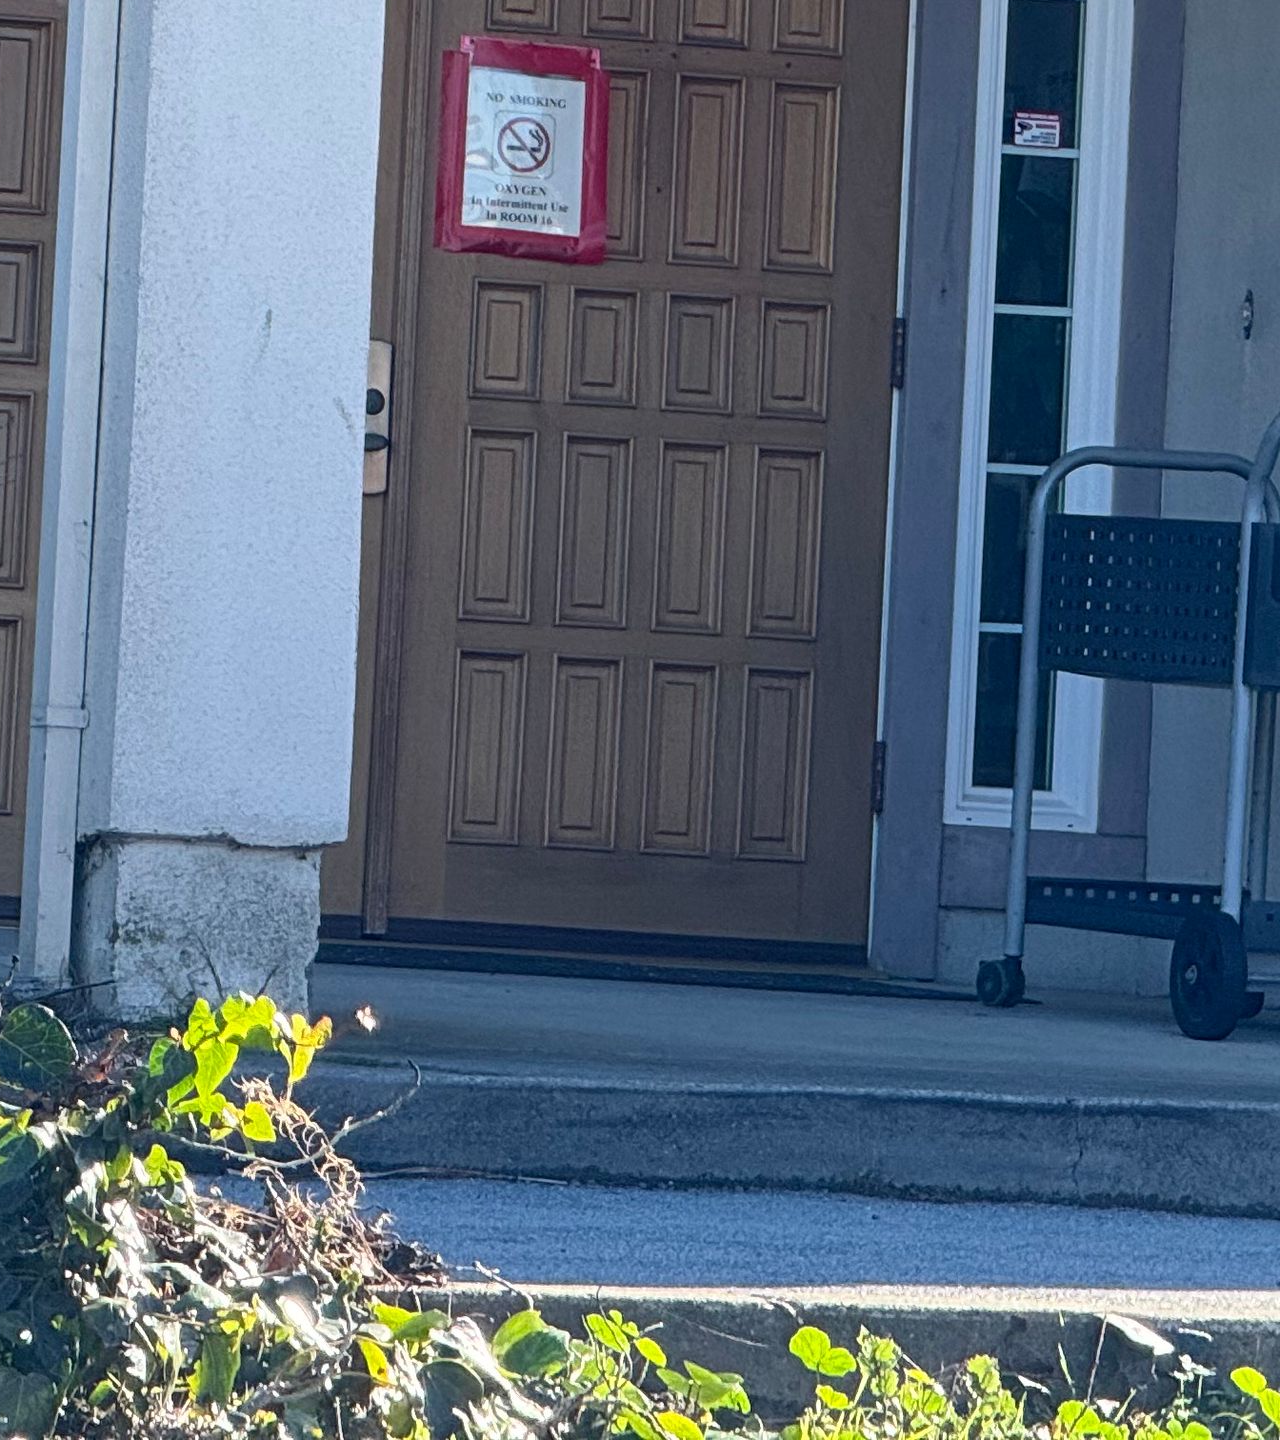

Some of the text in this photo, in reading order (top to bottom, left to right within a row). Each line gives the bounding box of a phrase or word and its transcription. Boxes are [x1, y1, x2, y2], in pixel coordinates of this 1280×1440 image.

[486, 92, 567, 109] NO SMOKING
[495, 183, 547, 197] OXYGEN
[486, 197, 548, 212] Intermittent
[486, 210, 497, 220] In
[500, 211, 538, 225] ROOM
